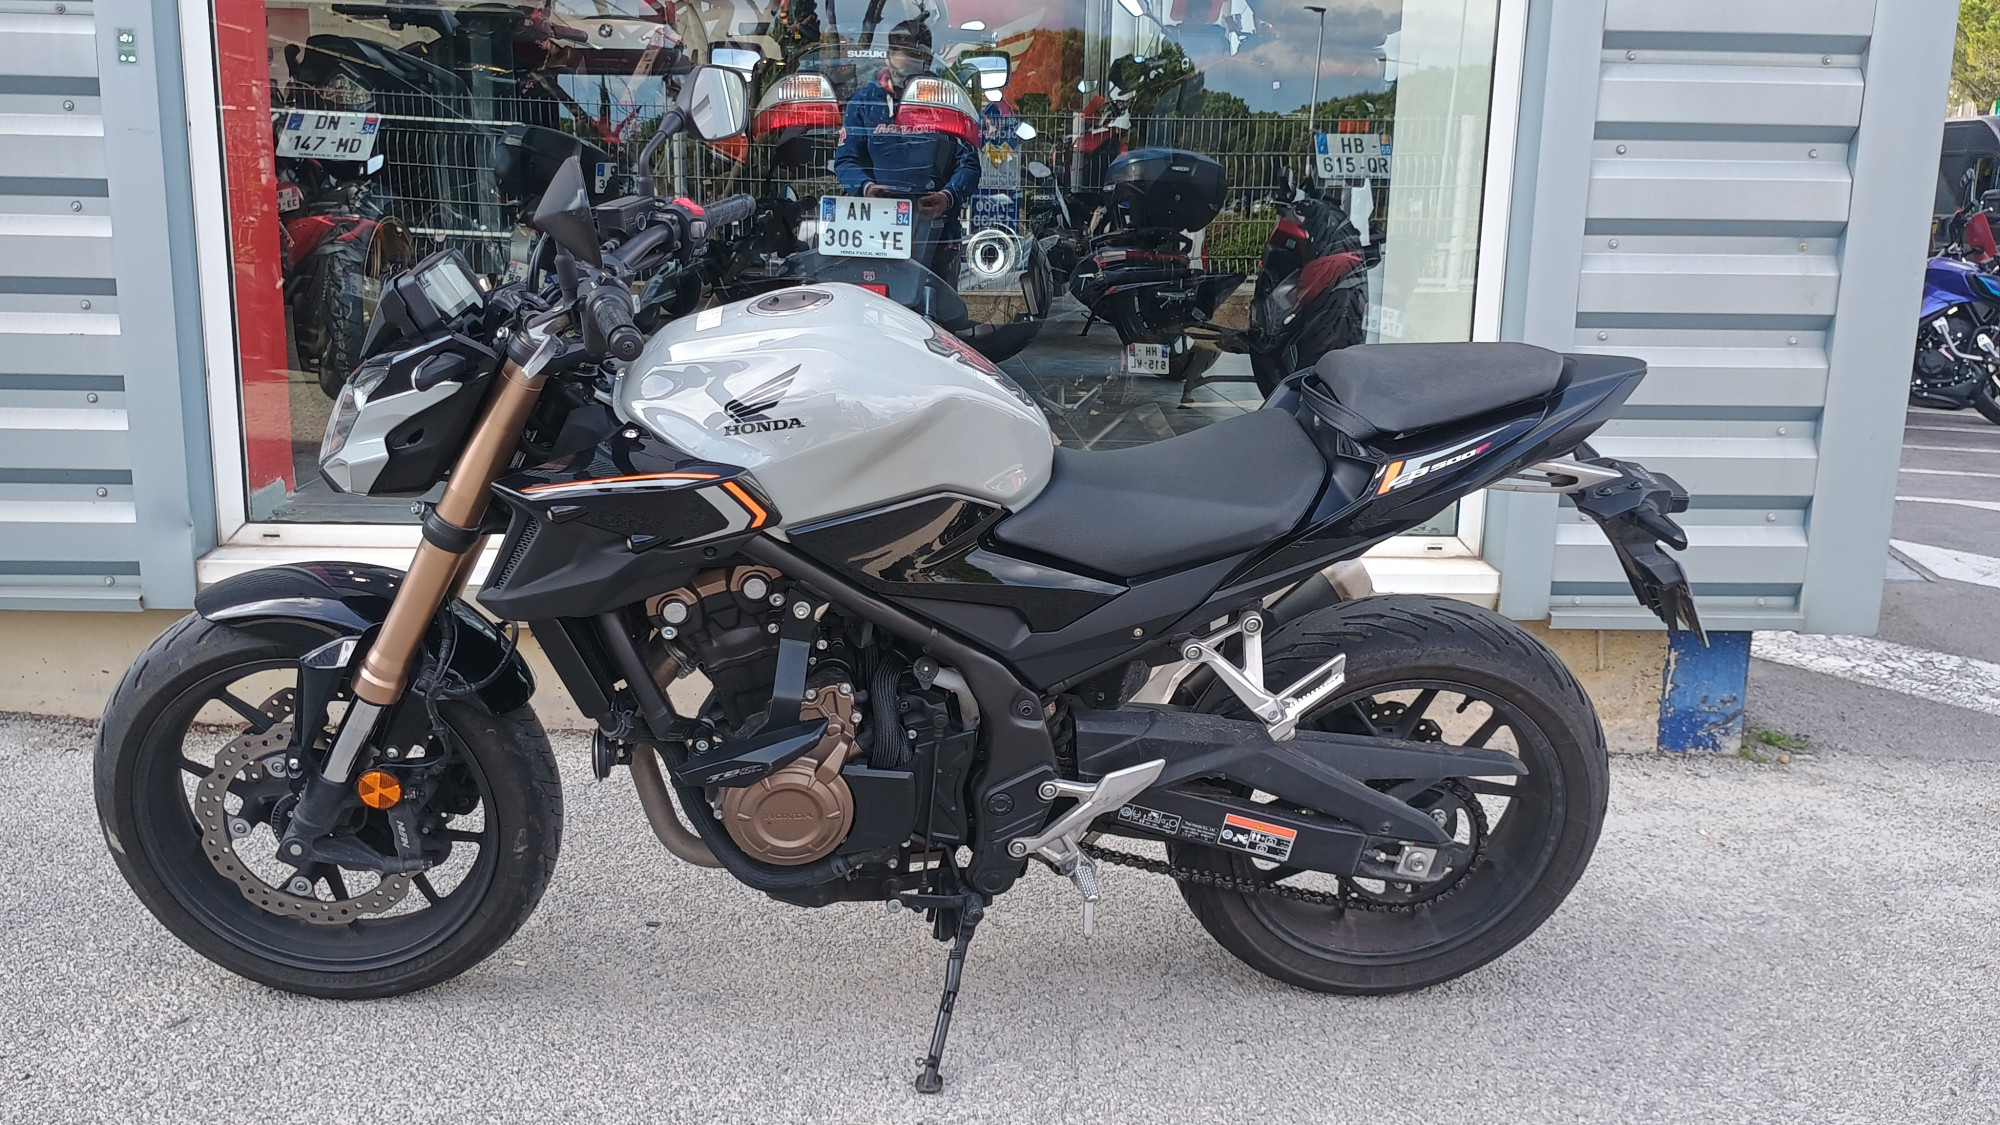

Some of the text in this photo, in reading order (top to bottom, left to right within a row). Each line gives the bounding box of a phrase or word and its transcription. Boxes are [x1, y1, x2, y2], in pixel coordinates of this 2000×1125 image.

[847, 50, 887, 58] SUZUKI
[315, 115, 341, 131] DN
[362, 124, 377, 135] 34
[1341, 138, 1365, 154] HB
[847, 201, 872, 221] AN
[897, 213, 909, 225] 34
[723, 417, 807, 437] HONDA
[763, 812, 815, 822] HONDA
